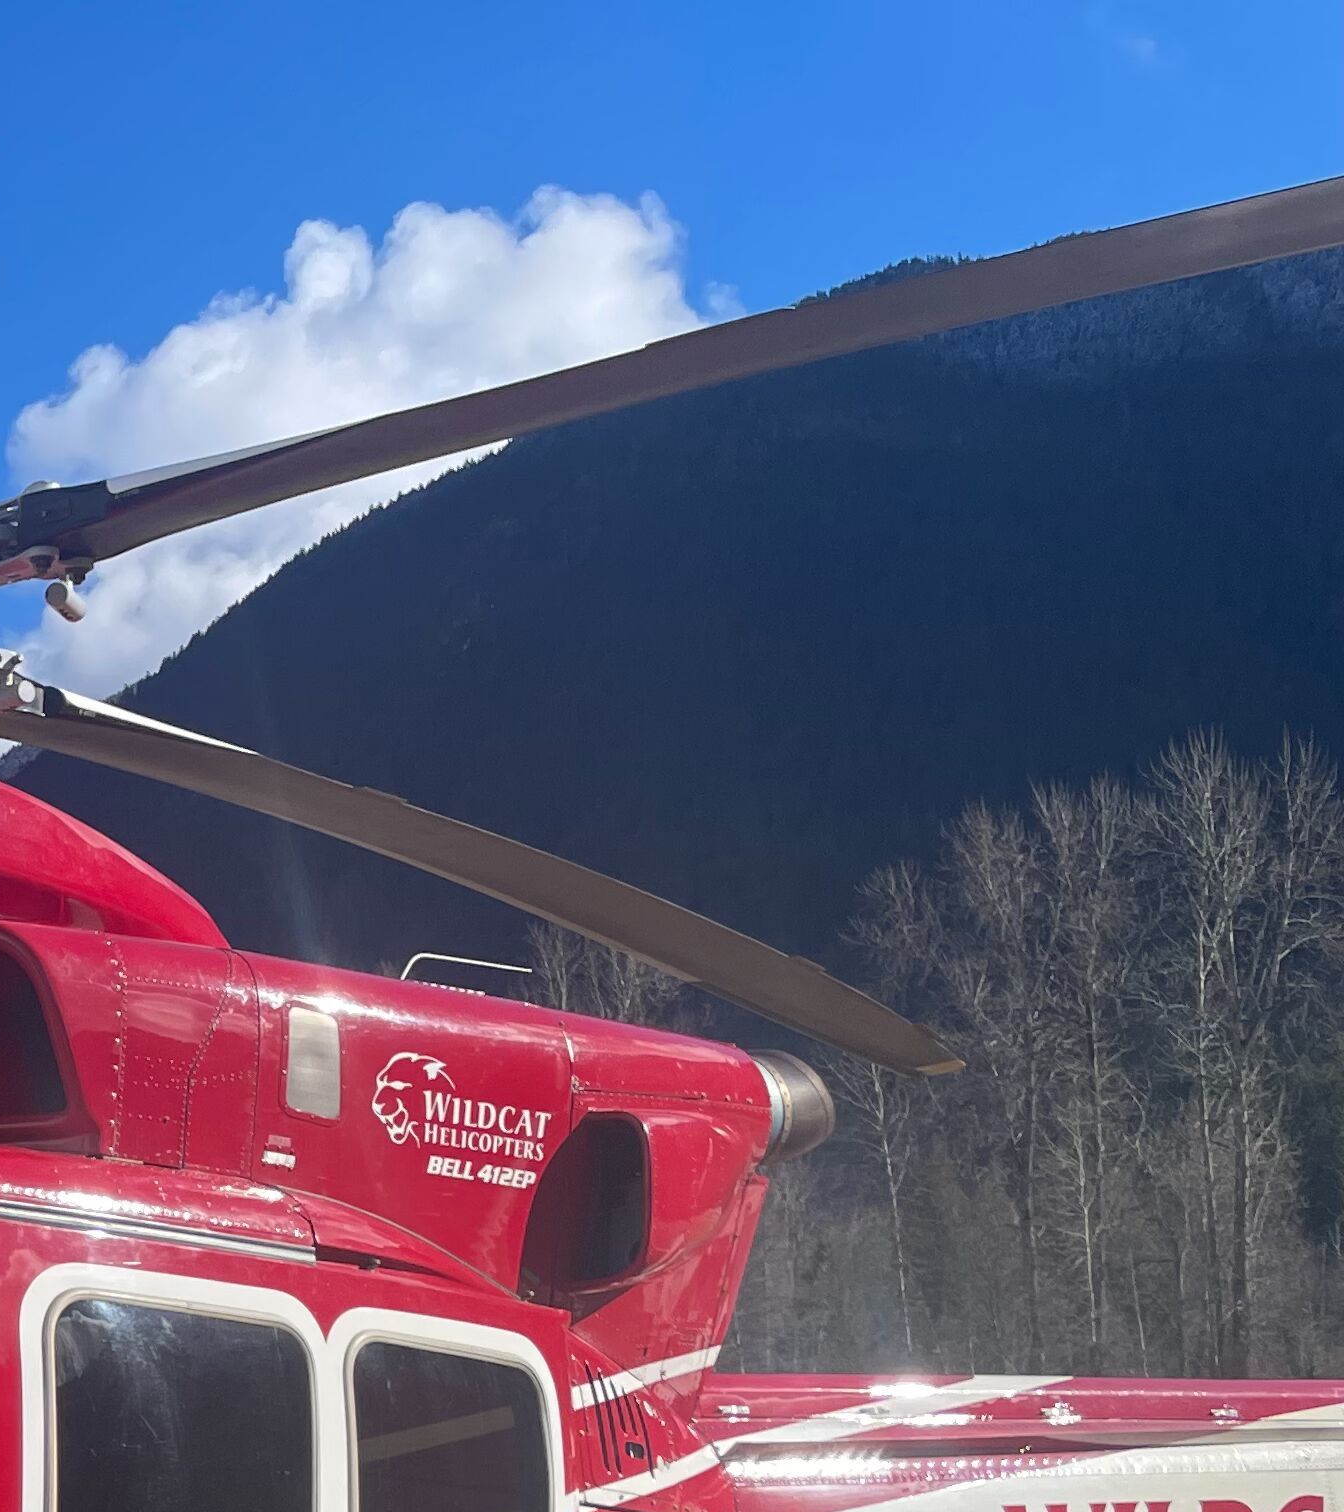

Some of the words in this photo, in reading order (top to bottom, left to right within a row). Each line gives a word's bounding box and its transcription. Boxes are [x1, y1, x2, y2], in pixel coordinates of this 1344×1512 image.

[423, 1090, 552, 1140] WILDCAT
[424, 1121, 545, 1162] HELICOPTERS
[426, 1155, 475, 1182] BELL
[477, 1163, 537, 1190] 412EP
